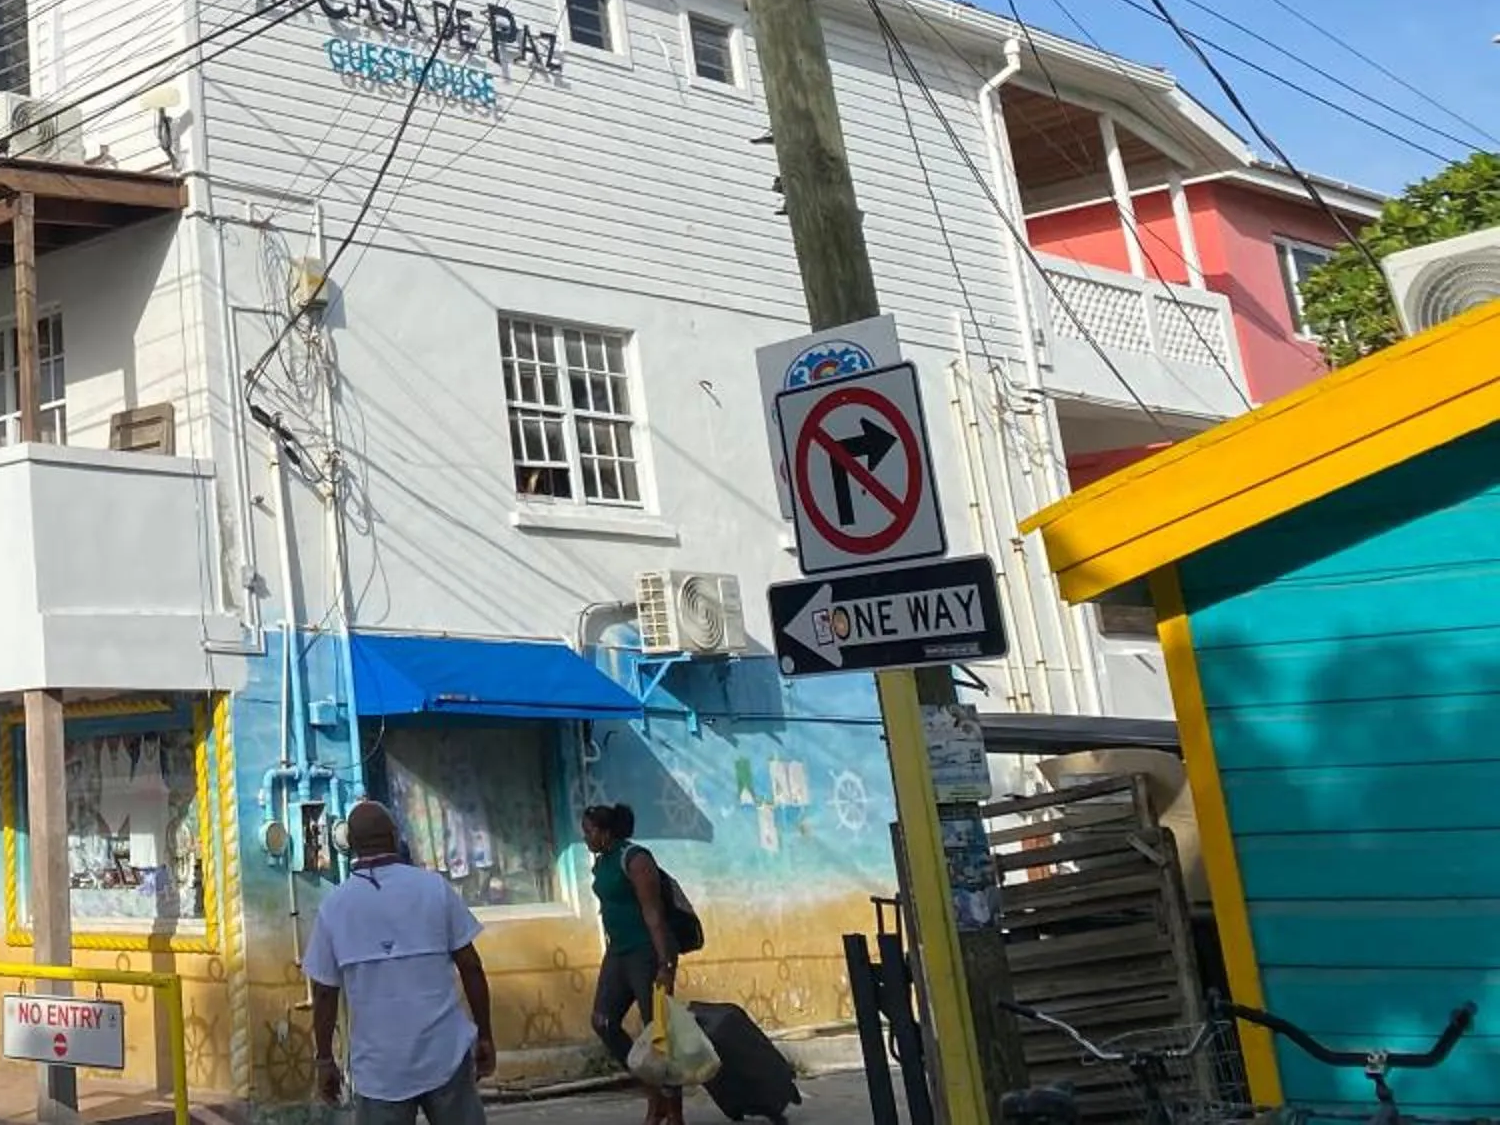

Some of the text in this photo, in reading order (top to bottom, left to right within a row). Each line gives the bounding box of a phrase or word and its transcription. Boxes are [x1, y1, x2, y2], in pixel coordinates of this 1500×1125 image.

[485, 3, 562, 75] PAZ
[831, 589, 975, 641] ONE WAY
[19, 1002, 42, 1024] NO
[47, 1004, 104, 1029] ENTRY
